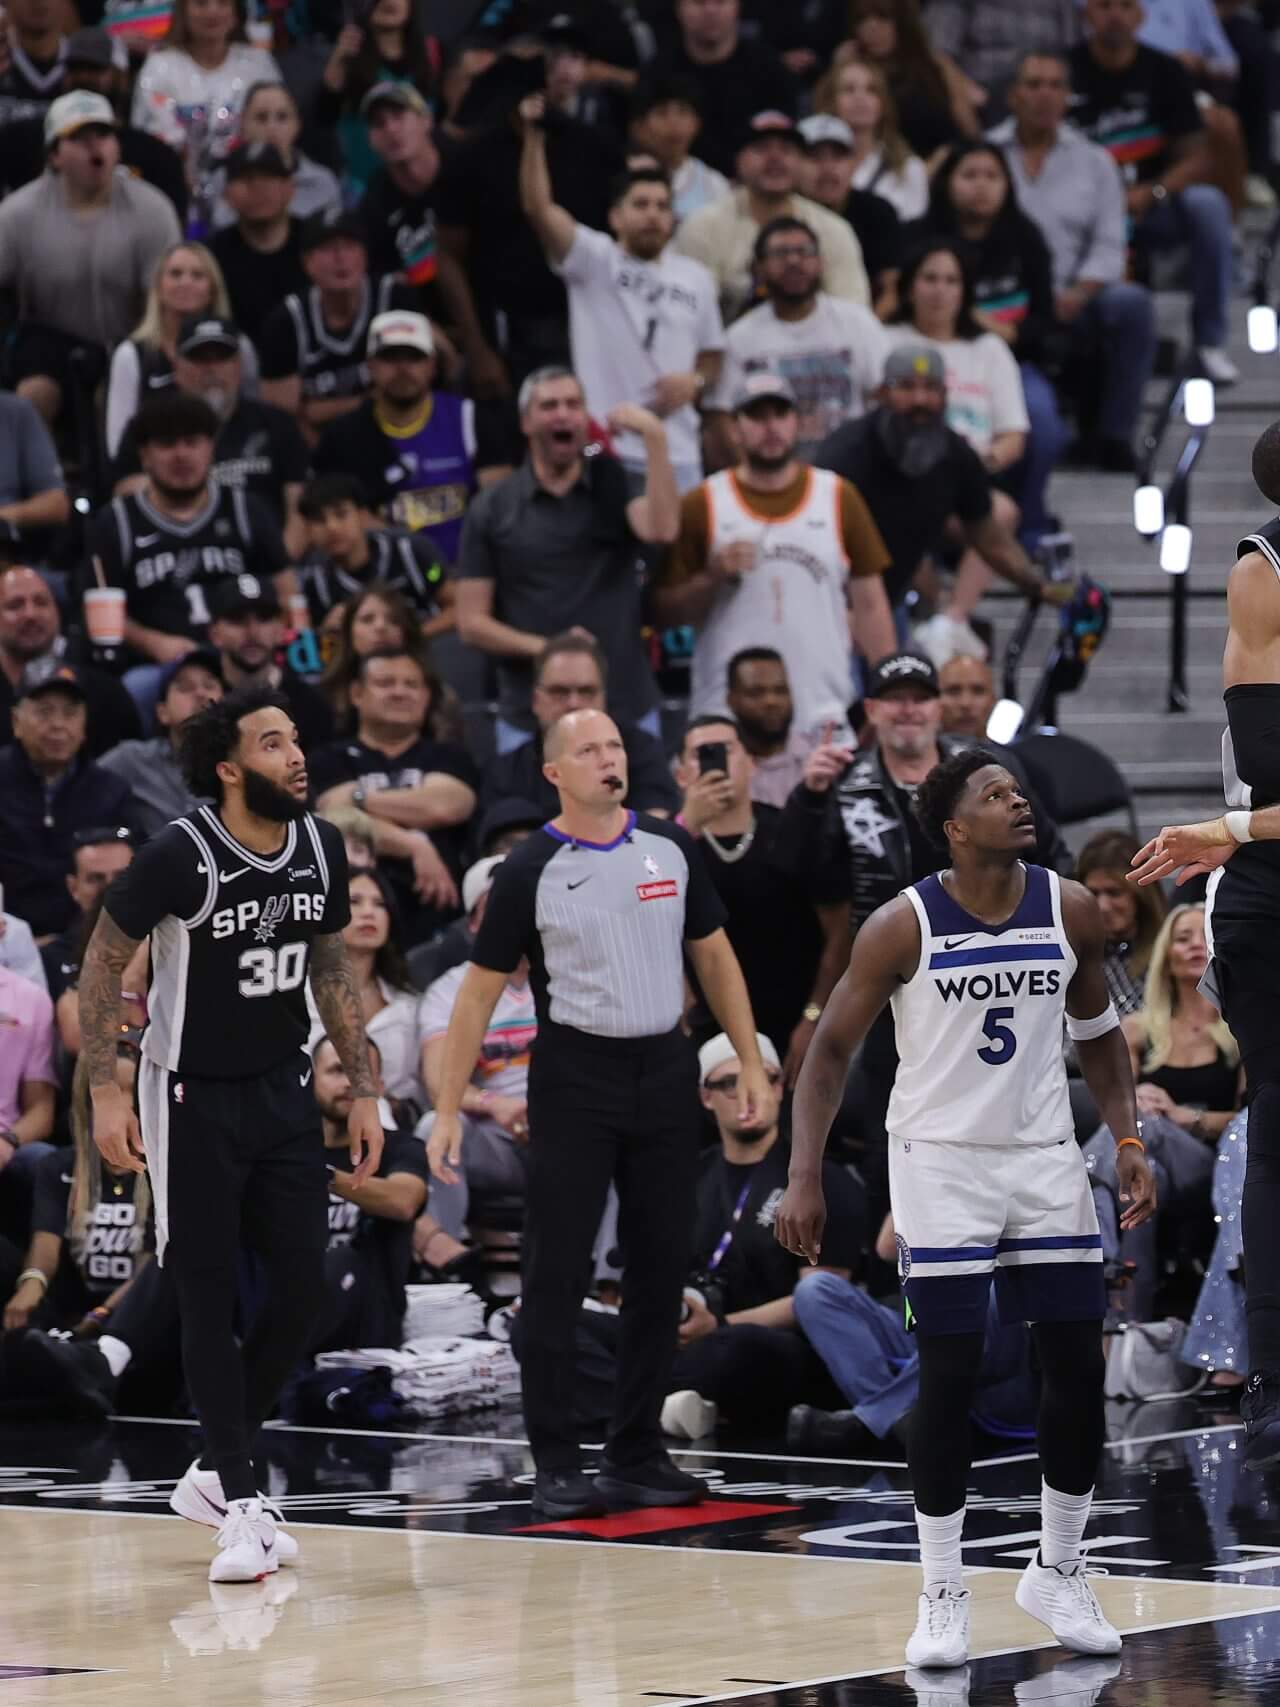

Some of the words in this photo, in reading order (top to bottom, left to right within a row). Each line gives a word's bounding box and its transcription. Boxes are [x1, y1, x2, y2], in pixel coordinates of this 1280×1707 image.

[212, 892, 326, 943] SPURS
[238, 941, 309, 998] 30
[934, 969, 1061, 1003] WOLVES
[976, 1006, 1017, 1066] 5
[95, 1202, 136, 1226] GO
[89, 1255, 132, 1279] GO
